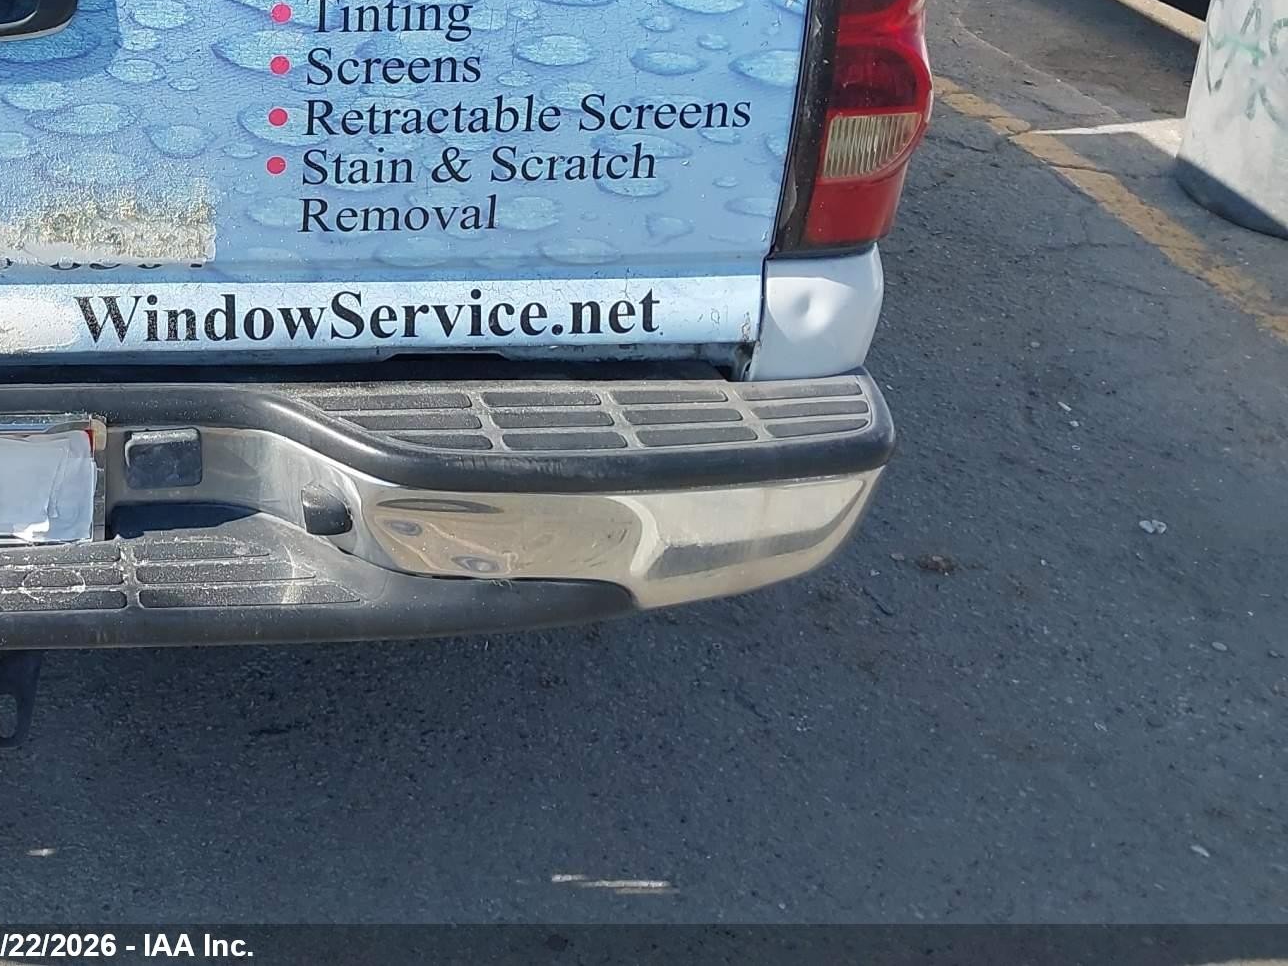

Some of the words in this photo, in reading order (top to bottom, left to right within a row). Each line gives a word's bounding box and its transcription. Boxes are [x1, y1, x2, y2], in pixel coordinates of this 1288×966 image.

[306, 48, 481, 86] Screens
[302, 95, 561, 136] Retractable
[578, 94, 751, 132] Screens
[302, 148, 414, 185] Stain
[431, 146, 472, 183] &
[490, 143, 656, 182] Scratch
[298, 194, 497, 233] Removal
[75, 288, 661, 343] WindowService.net
